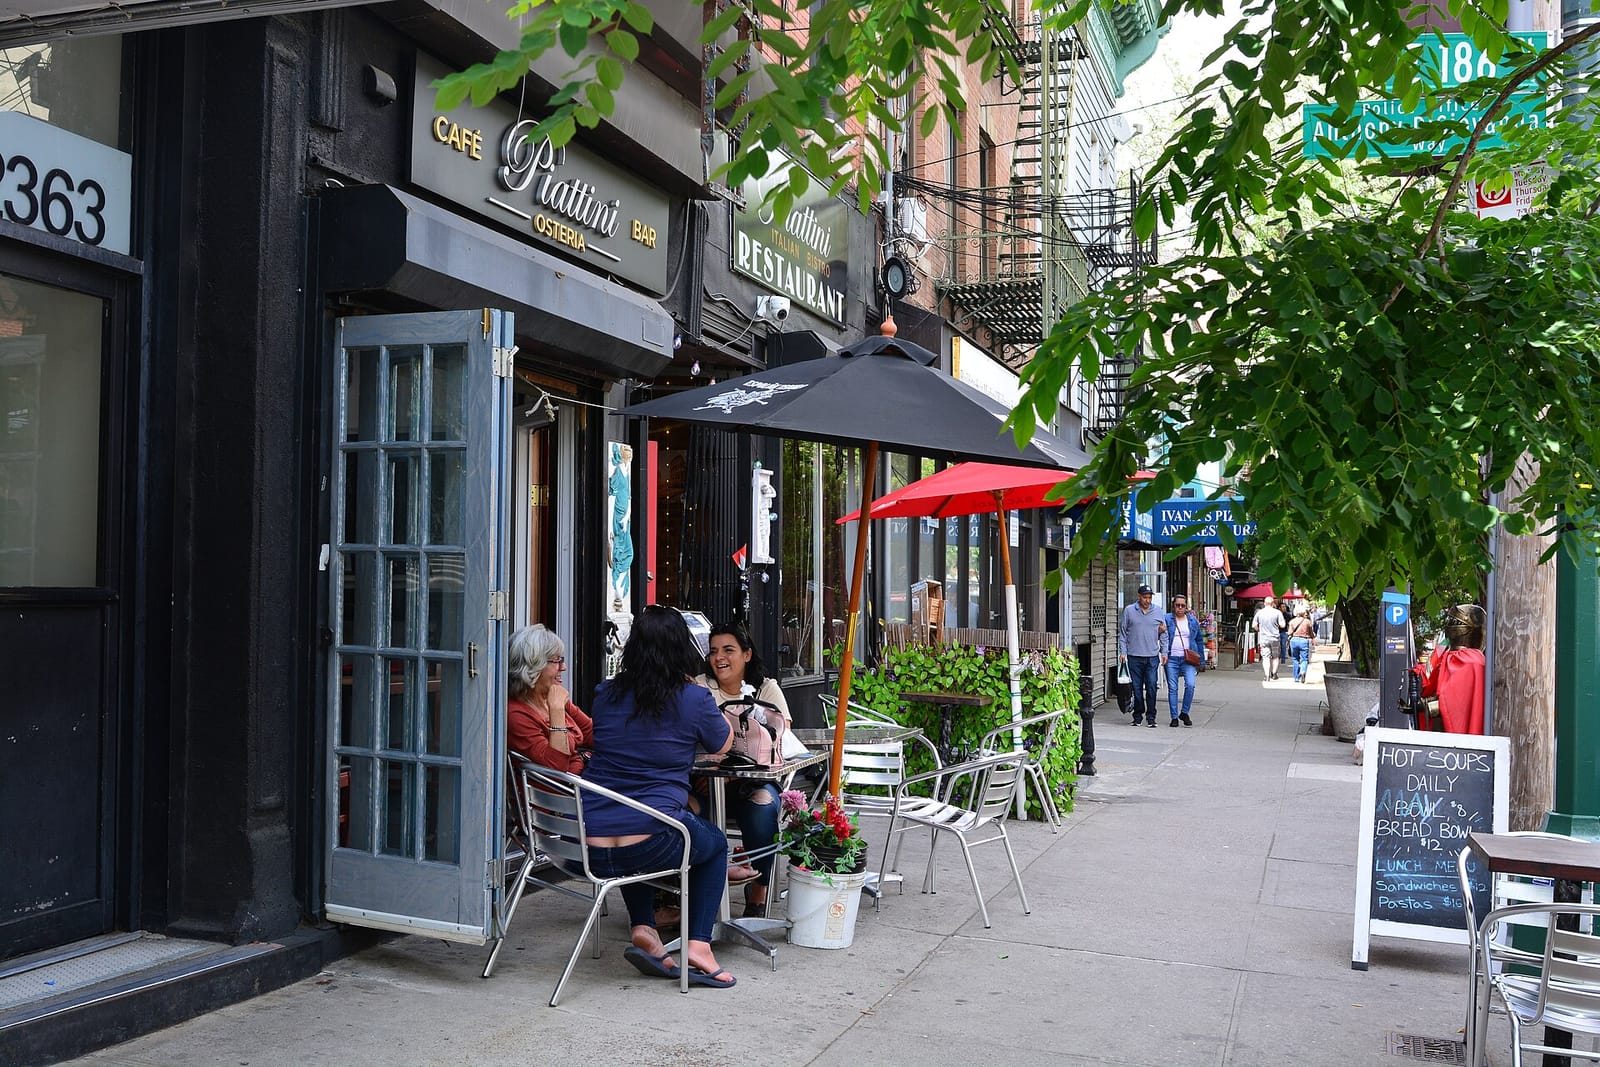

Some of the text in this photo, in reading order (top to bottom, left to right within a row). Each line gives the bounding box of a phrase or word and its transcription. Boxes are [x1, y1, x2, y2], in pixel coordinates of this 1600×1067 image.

[1439, 41, 1497, 84] 186
[1363, 101, 1415, 116] Polic
[433, 116, 482, 160] CAFÉ
[499, 119, 621, 238] Piattini
[0, 153, 106, 246] 363
[533, 213, 586, 252] OSTERIA
[631, 219, 657, 248] BAR
[771, 228, 831, 278] ITALIAN BISTRO
[738, 230, 844, 323] RESTAURANT
[1392, 606, 1404, 622] P
[1381, 747, 1490, 772] HOT SOUPS
[1407, 774, 1459, 792] DAILY
[1450, 800, 1467, 817] $8
[1376, 819, 1432, 838] BREAD
[1420, 837, 1443, 851] $12
[1375, 859, 1477, 873] LUNCH MEU
[1375, 880, 1458, 892] Sandwiches
[1378, 896, 1433, 910] Pastas
